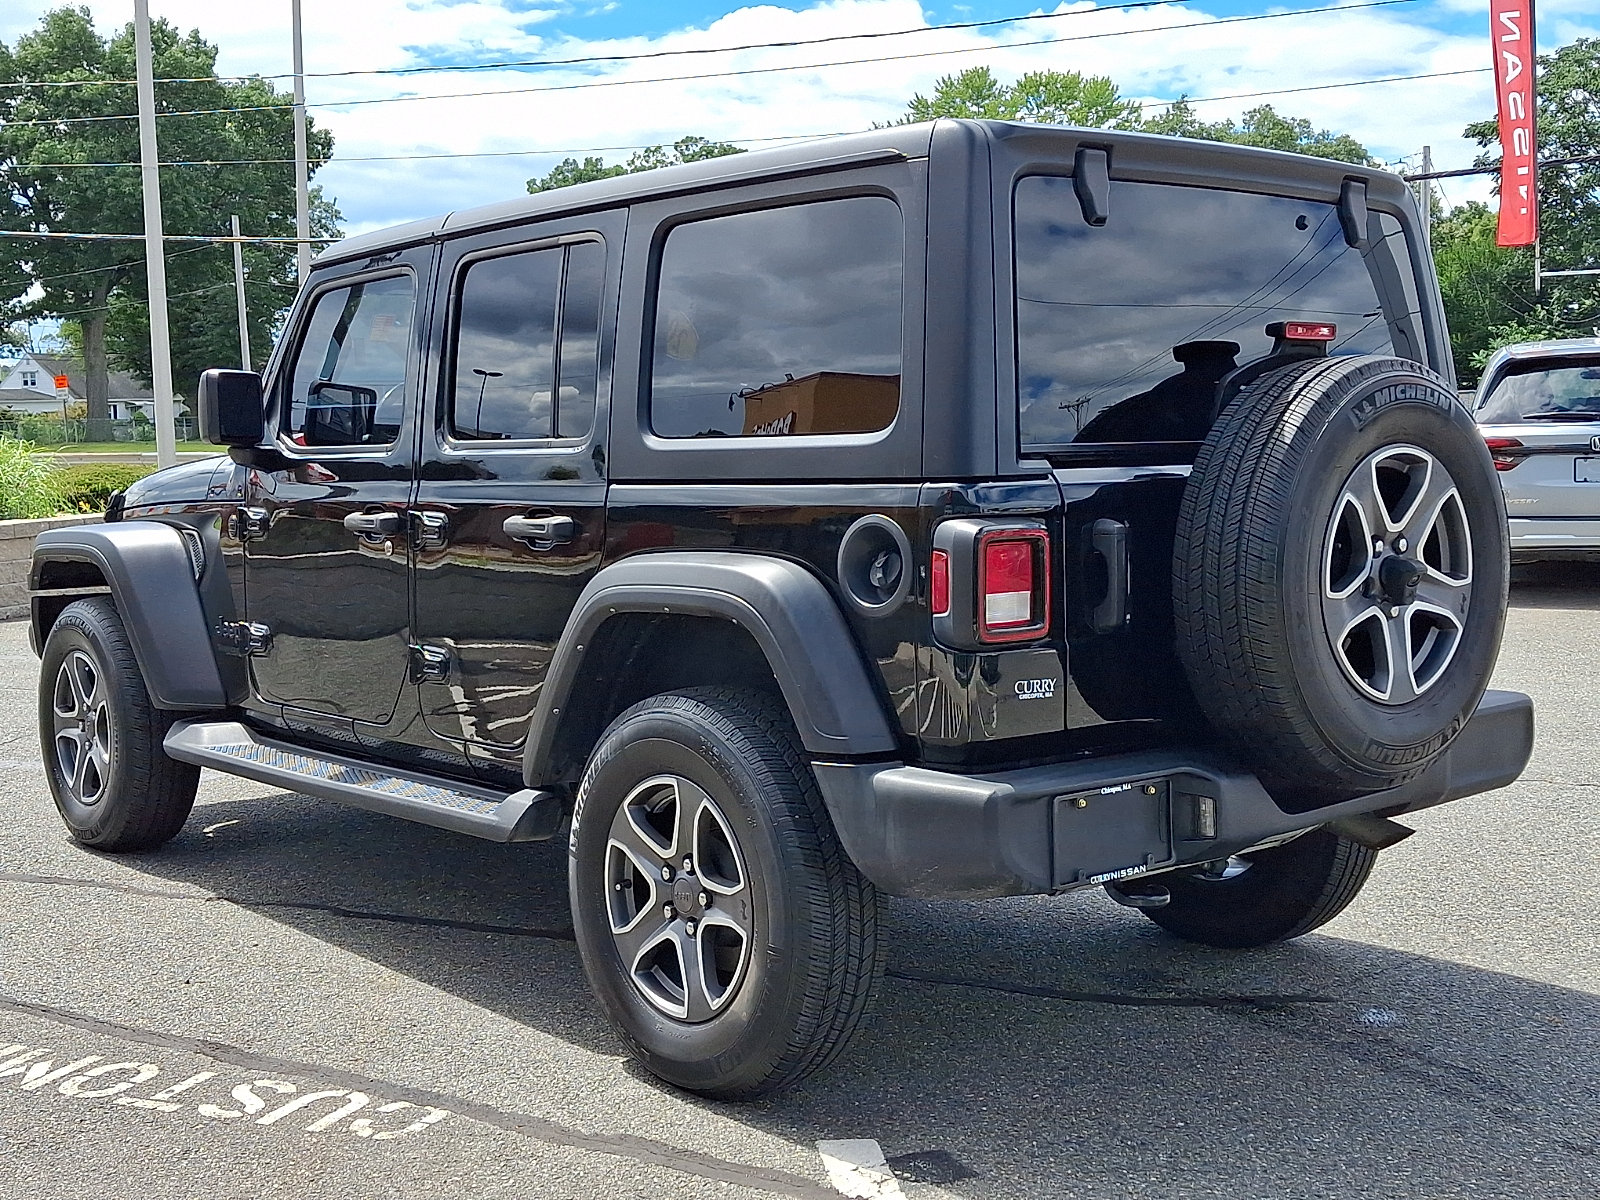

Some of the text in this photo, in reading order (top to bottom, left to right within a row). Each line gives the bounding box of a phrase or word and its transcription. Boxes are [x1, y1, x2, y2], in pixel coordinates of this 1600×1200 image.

[1374, 384, 1451, 410] MICHELIN
[1014, 678, 1057, 694] CURRY
[573, 738, 614, 823] MICHELI
